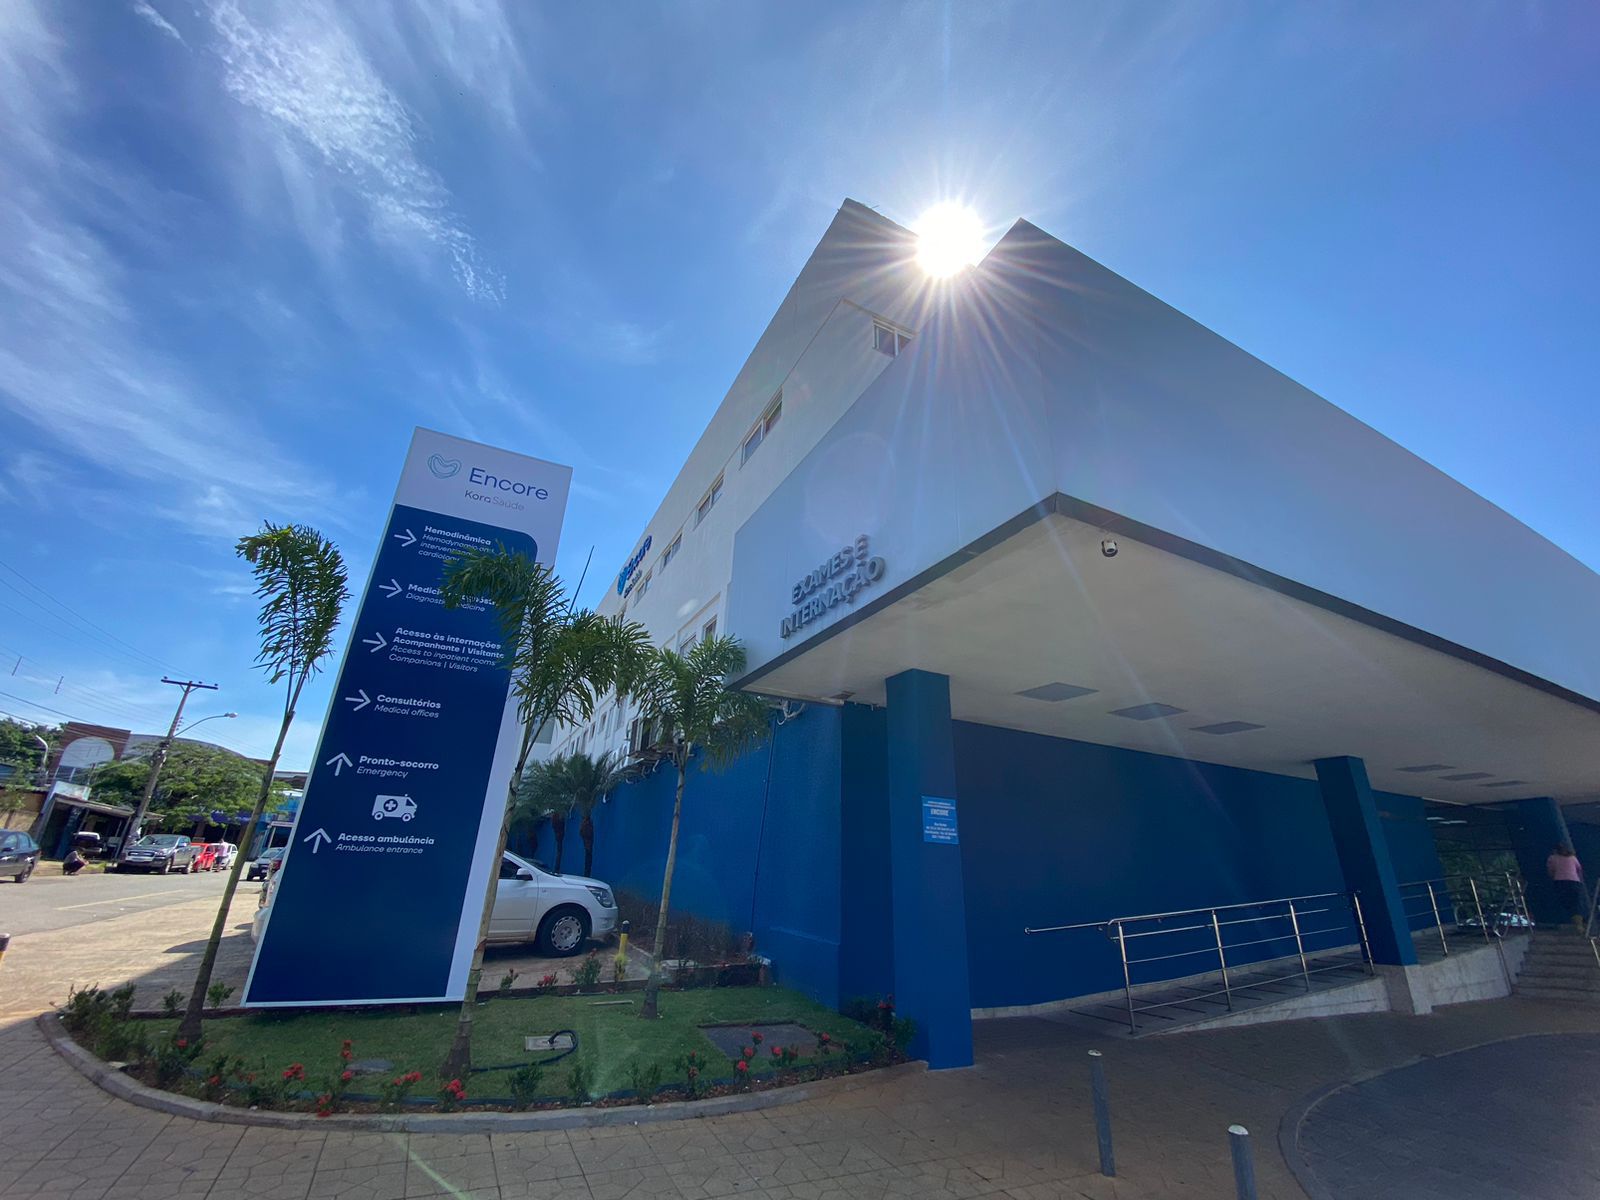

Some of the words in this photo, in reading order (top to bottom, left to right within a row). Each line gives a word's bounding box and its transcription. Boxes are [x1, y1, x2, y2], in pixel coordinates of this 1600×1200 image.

[469, 467, 549, 500] Encore
[424, 525, 492, 546] Hemodinâmica
[792, 546, 855, 605] EXAMES
[854, 534, 870, 560] E
[780, 556, 885, 639] INTERNAÇÃO
[392, 636, 460, 653] Acompanhante
[395, 627, 431, 640] Acesso
[446, 635, 502, 649] internações
[388, 653, 442, 668] Companions
[448, 662, 478, 673] Visitors
[390, 645, 422, 656] Access
[433, 651, 470, 664] inpatient
[470, 658, 496, 667] rooms
[376, 694, 442, 709] Consultórios
[374, 704, 410, 715] Medical
[410, 709, 440, 719] offices
[359, 755, 439, 770] Pronto-socorro
[356, 766, 409, 778] Emergency
[337, 832, 375, 842] Acesso
[377, 835, 435, 845] ambulância
[335, 843, 385, 853] Ambulance
[386, 846, 424, 854] entrance
